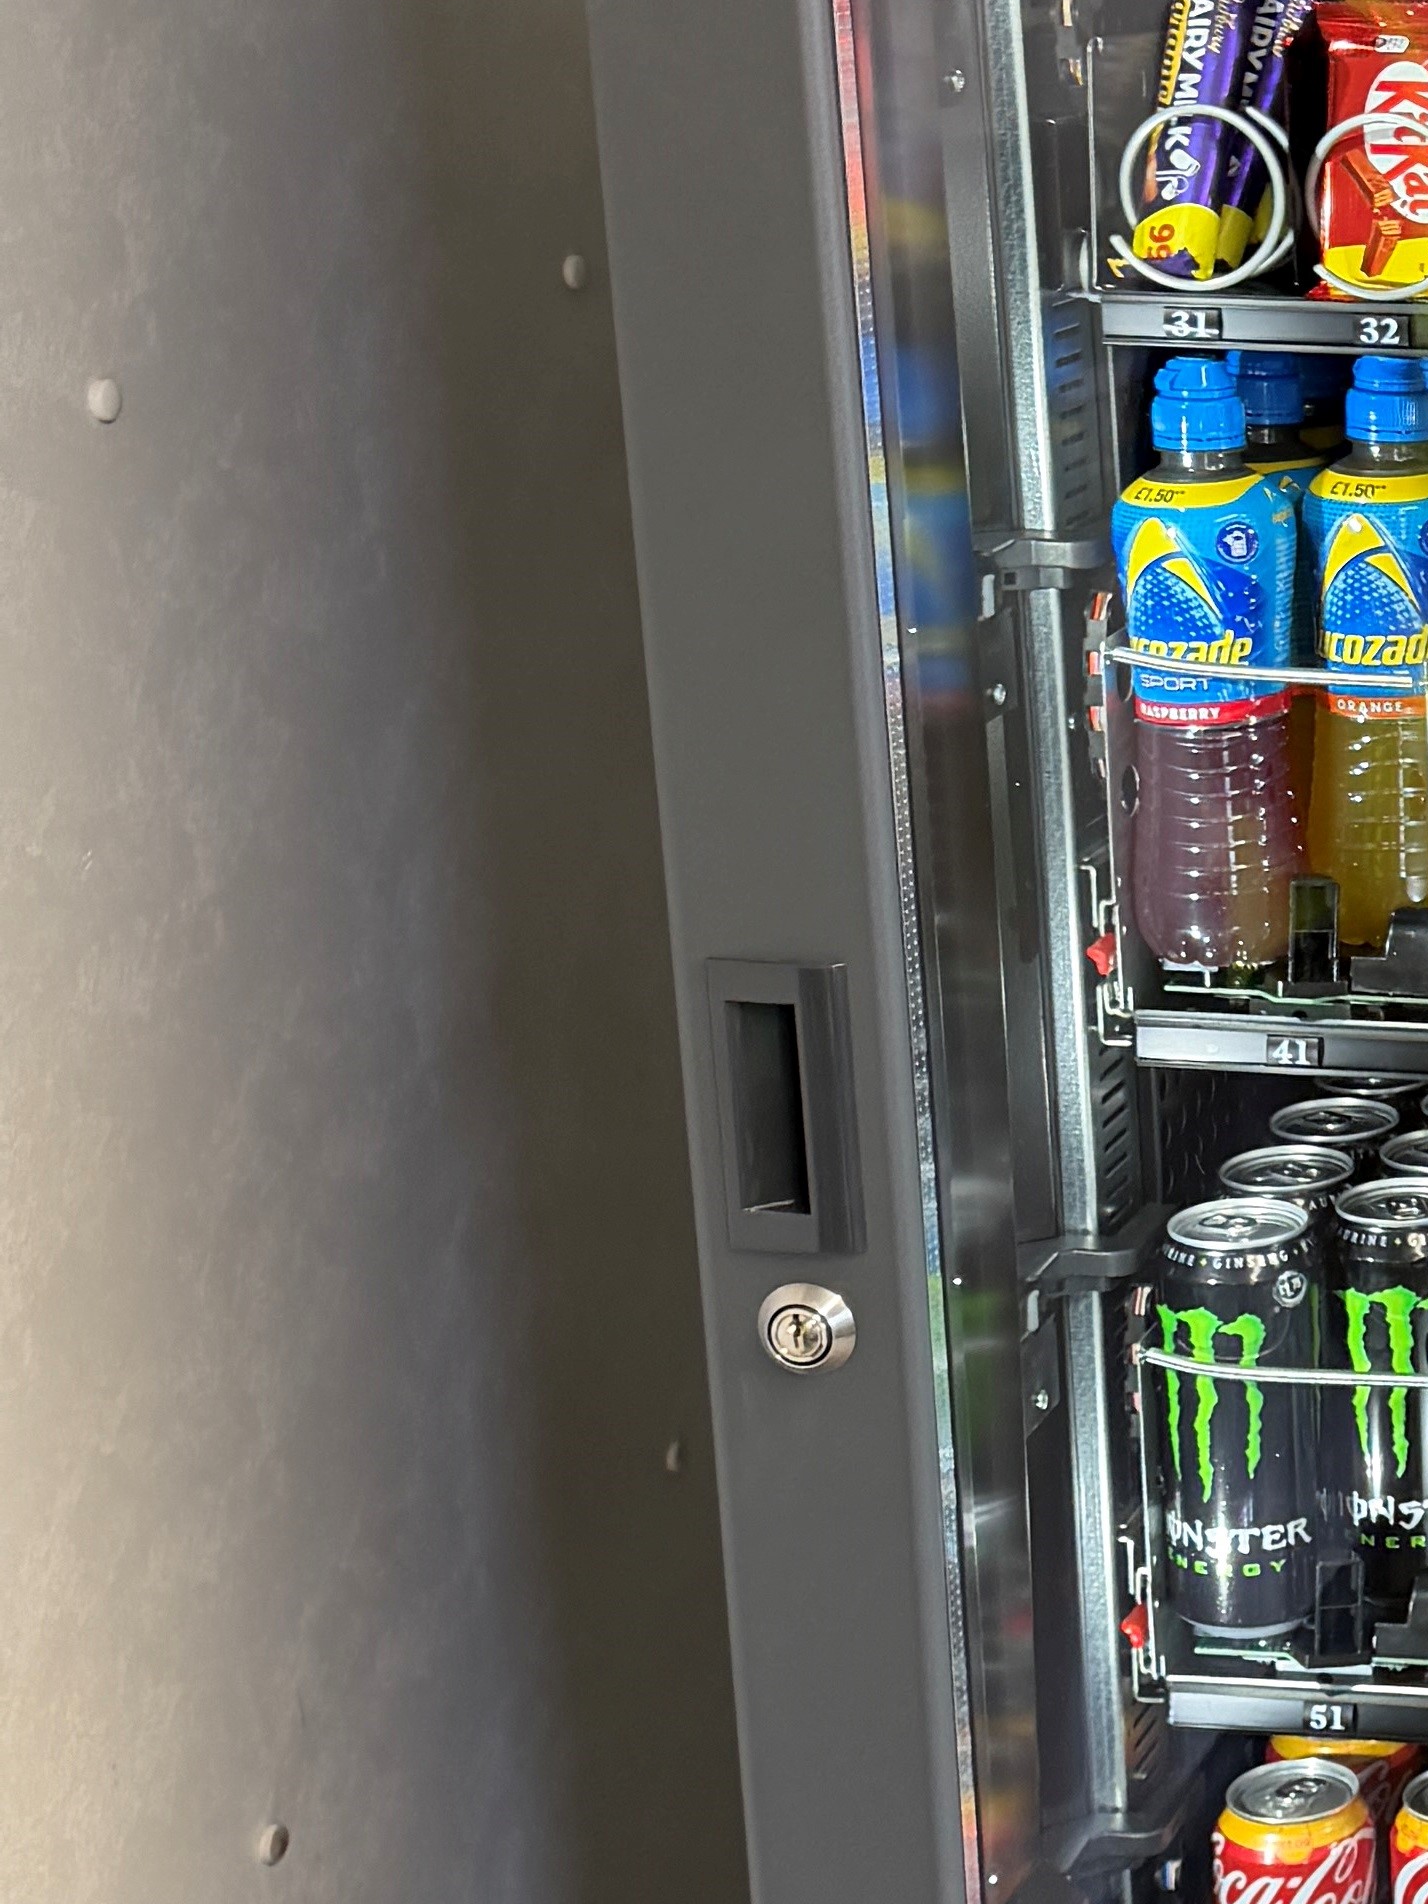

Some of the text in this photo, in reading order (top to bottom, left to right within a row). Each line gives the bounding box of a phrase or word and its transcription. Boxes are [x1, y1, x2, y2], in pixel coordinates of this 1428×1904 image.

[1358, 317, 1401, 345] 32
[1140, 673, 1210, 692] SPORT
[1336, 698, 1404, 716] ORANGE
[1271, 1038, 1311, 1064] 41
[1309, 1707, 1348, 1732] 51
